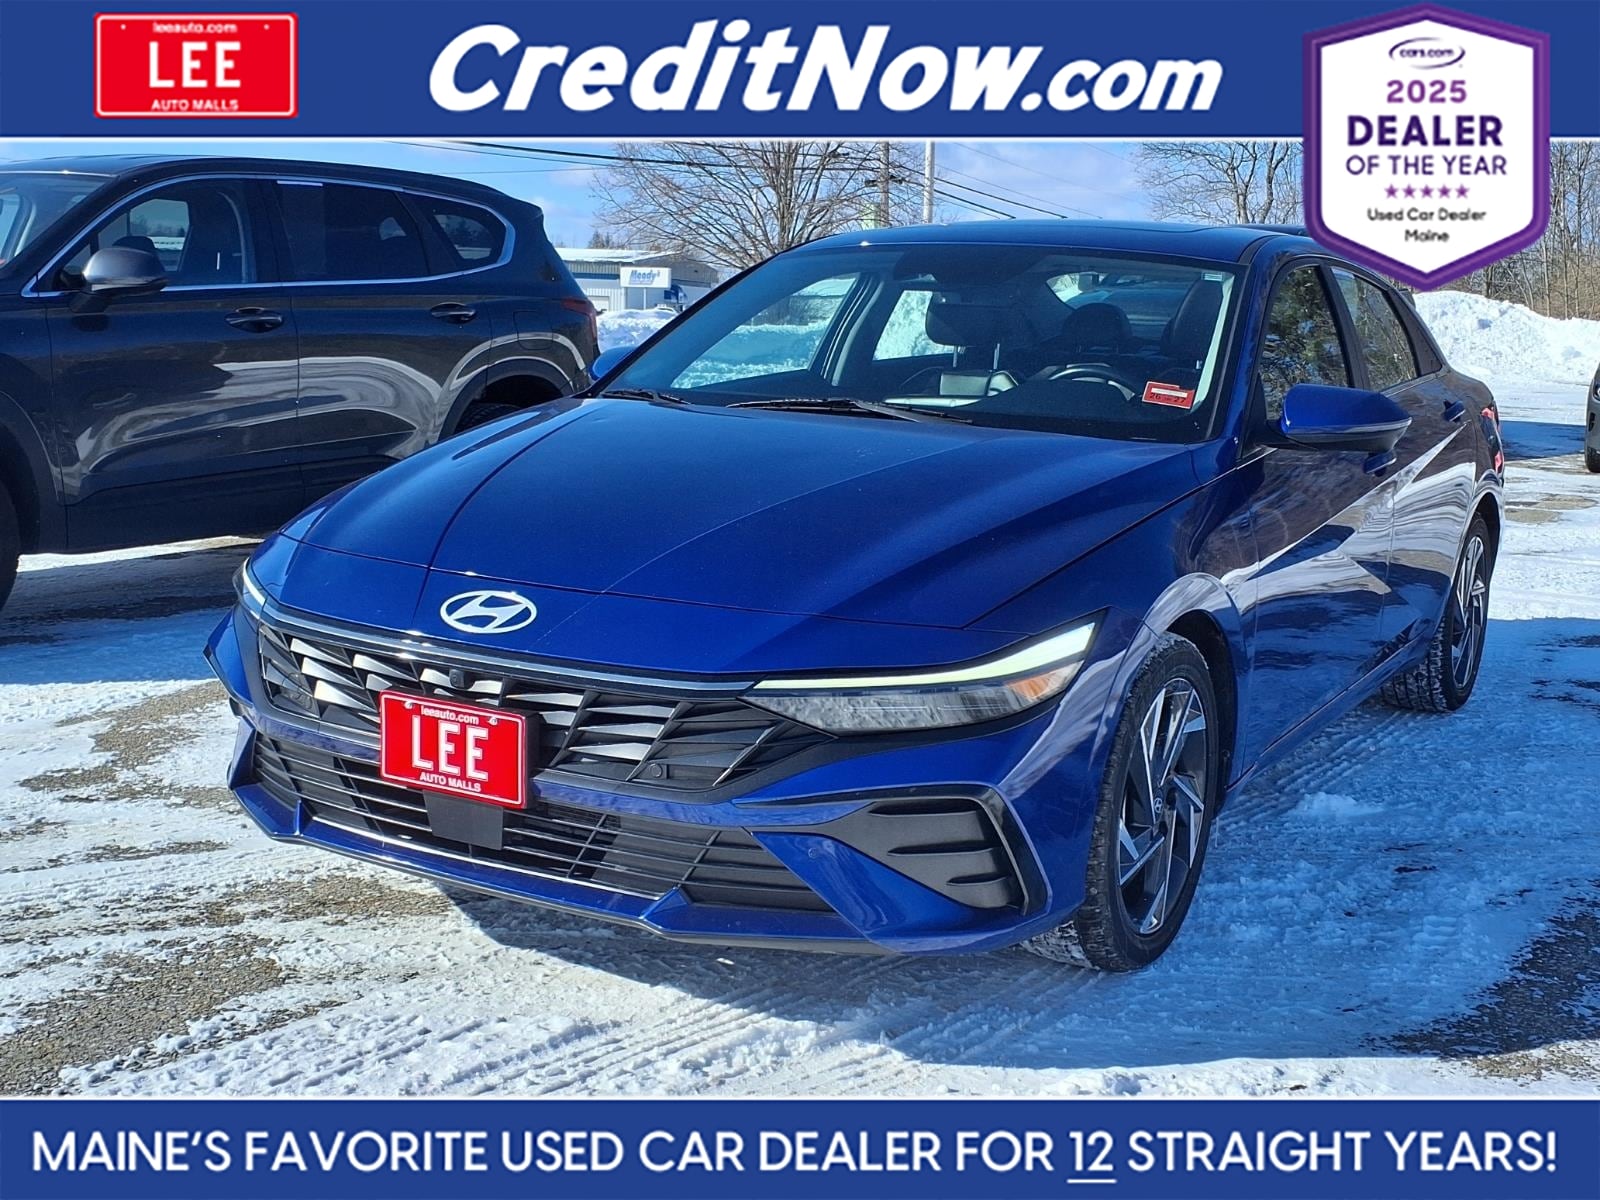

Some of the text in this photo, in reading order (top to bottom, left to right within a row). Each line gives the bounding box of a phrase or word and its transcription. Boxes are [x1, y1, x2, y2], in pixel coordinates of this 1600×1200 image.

[420, 705, 480, 725] leeauto.com
[412, 714, 489, 782] LEE
[420, 771, 482, 793] AUTO MALLS
